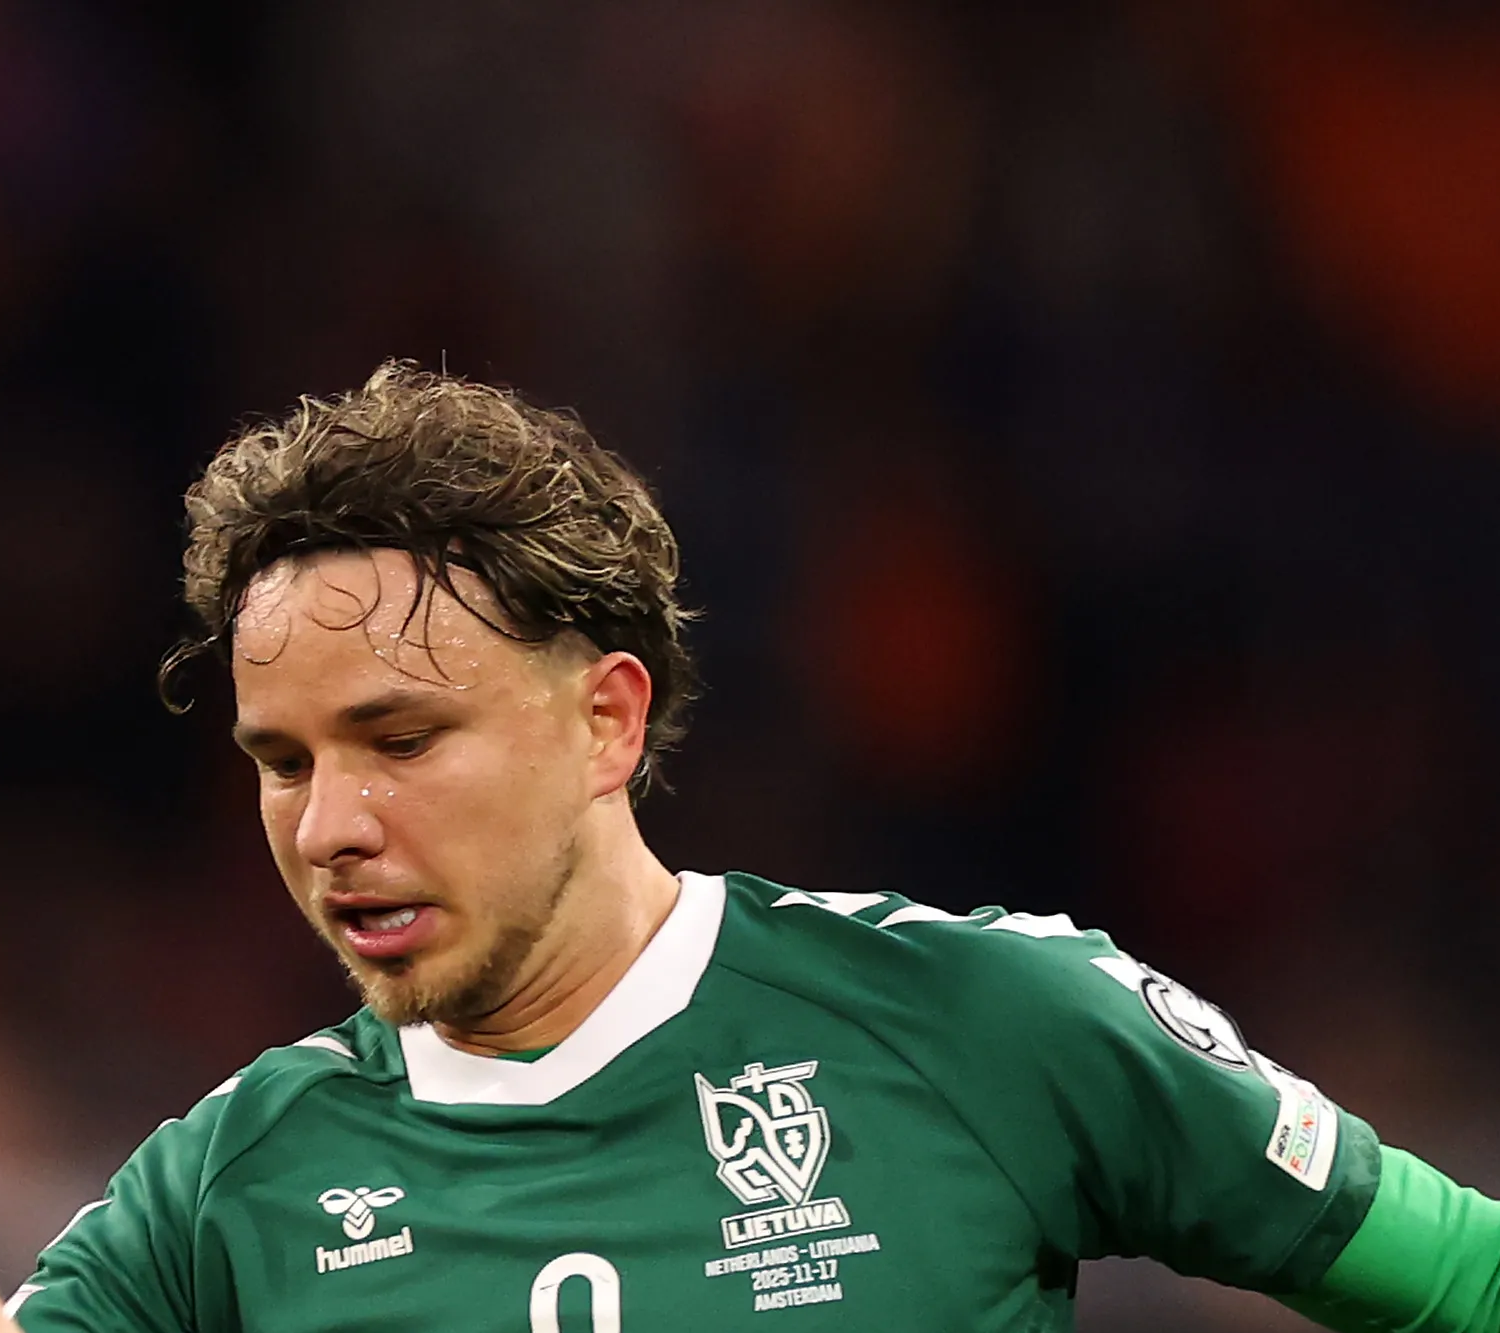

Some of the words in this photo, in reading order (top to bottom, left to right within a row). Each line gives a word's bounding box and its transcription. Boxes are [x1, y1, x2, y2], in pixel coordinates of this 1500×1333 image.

[728, 1203, 843, 1243] LIETUVA
[316, 1226, 414, 1274] hummel
[705, 1245, 799, 1278] NETHERLANDS
[808, 1233, 881, 1259] LITHUANIA
[751, 1259, 838, 1291] 2025-11-17
[754, 1282, 844, 1312] AMSTERDAM
